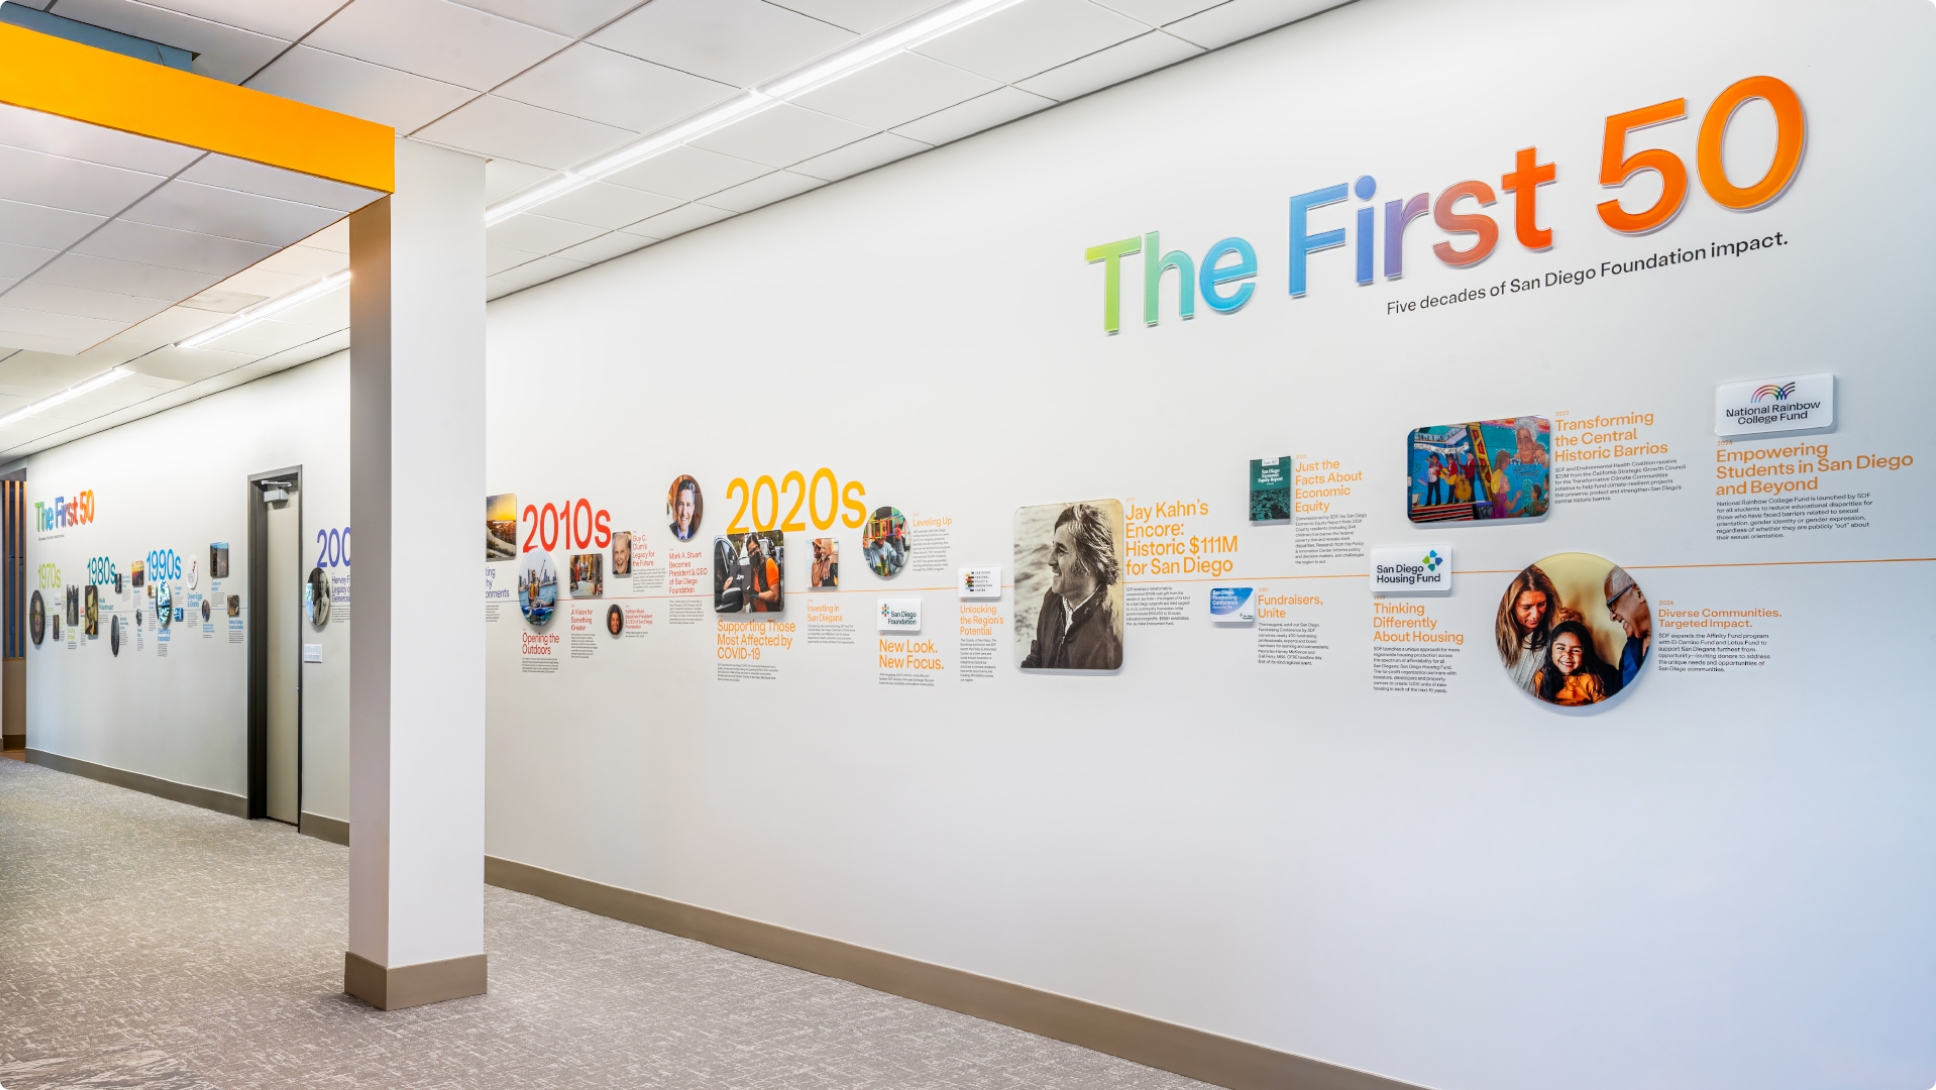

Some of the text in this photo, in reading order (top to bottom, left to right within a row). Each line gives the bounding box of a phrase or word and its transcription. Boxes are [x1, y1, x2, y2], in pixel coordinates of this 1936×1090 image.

[1085, 75, 1806, 334] The First 50
[1387, 232, 1788, 315] Five decades of San Diego Foundation impact.
[1726, 402, 1821, 417] National Rainbow
[1555, 411, 1654, 431] Transforming
[1738, 411, 1808, 425] College Fund
[1555, 428, 1638, 446] the Central
[1555, 442, 1668, 462] Historic Barrios
[1717, 443, 1828, 463] Empowering
[1296, 459, 1340, 472] Just the
[1716, 454, 1913, 479] Students in San Diego
[1295, 471, 1362, 486] Facts About
[1295, 485, 1350, 499] Economic
[1716, 476, 1818, 496] and Beyond
[726, 467, 866, 534] 2020s
[1295, 500, 1330, 514] Equity
[35, 489, 94, 532] The First 50
[1126, 499, 1209, 523] Jay Kahn's
[523, 498, 611, 553] 2010s
[913, 517, 952, 527] Leveling Up
[1126, 523, 1184, 538] Encore:
[317, 527, 350, 568] 200
[1126, 535, 1238, 556] Historic $111M
[87, 556, 116, 585] 1980s
[146, 549, 181, 581] 1990s
[1126, 556, 1233, 577] for San Diego
[1377, 564, 1424, 574] San Diego
[38, 563, 61, 589] 1970s
[486, 567, 495, 578] ting
[1377, 573, 1441, 585] Housing Fund
[486, 589, 509, 598] onments
[1258, 594, 1323, 605] Fundraisers,
[808, 604, 833, 614] Investing
[901, 611, 917, 619] Diego
[960, 605, 997, 615] Unlocking
[1258, 608, 1286, 618] Unite
[1374, 602, 1425, 616] Thinking
[1658, 608, 1782, 617] Diverse Communities.
[819, 615, 842, 623] Diegans
[960, 616, 1004, 626] the Region's
[1373, 617, 1437, 630] Differently
[1659, 619, 1752, 629] Targeted Impact.
[718, 619, 796, 634] Supporting Those
[960, 626, 992, 635] Potential
[522, 632, 559, 645] Opening the
[718, 634, 792, 650] Most Affected by
[1373, 631, 1464, 645] About Housing
[522, 644, 551, 654] Outdoors
[718, 647, 760, 659] COVID-19
[880, 639, 938, 653] New Look.
[880, 655, 944, 669] New Focus.
